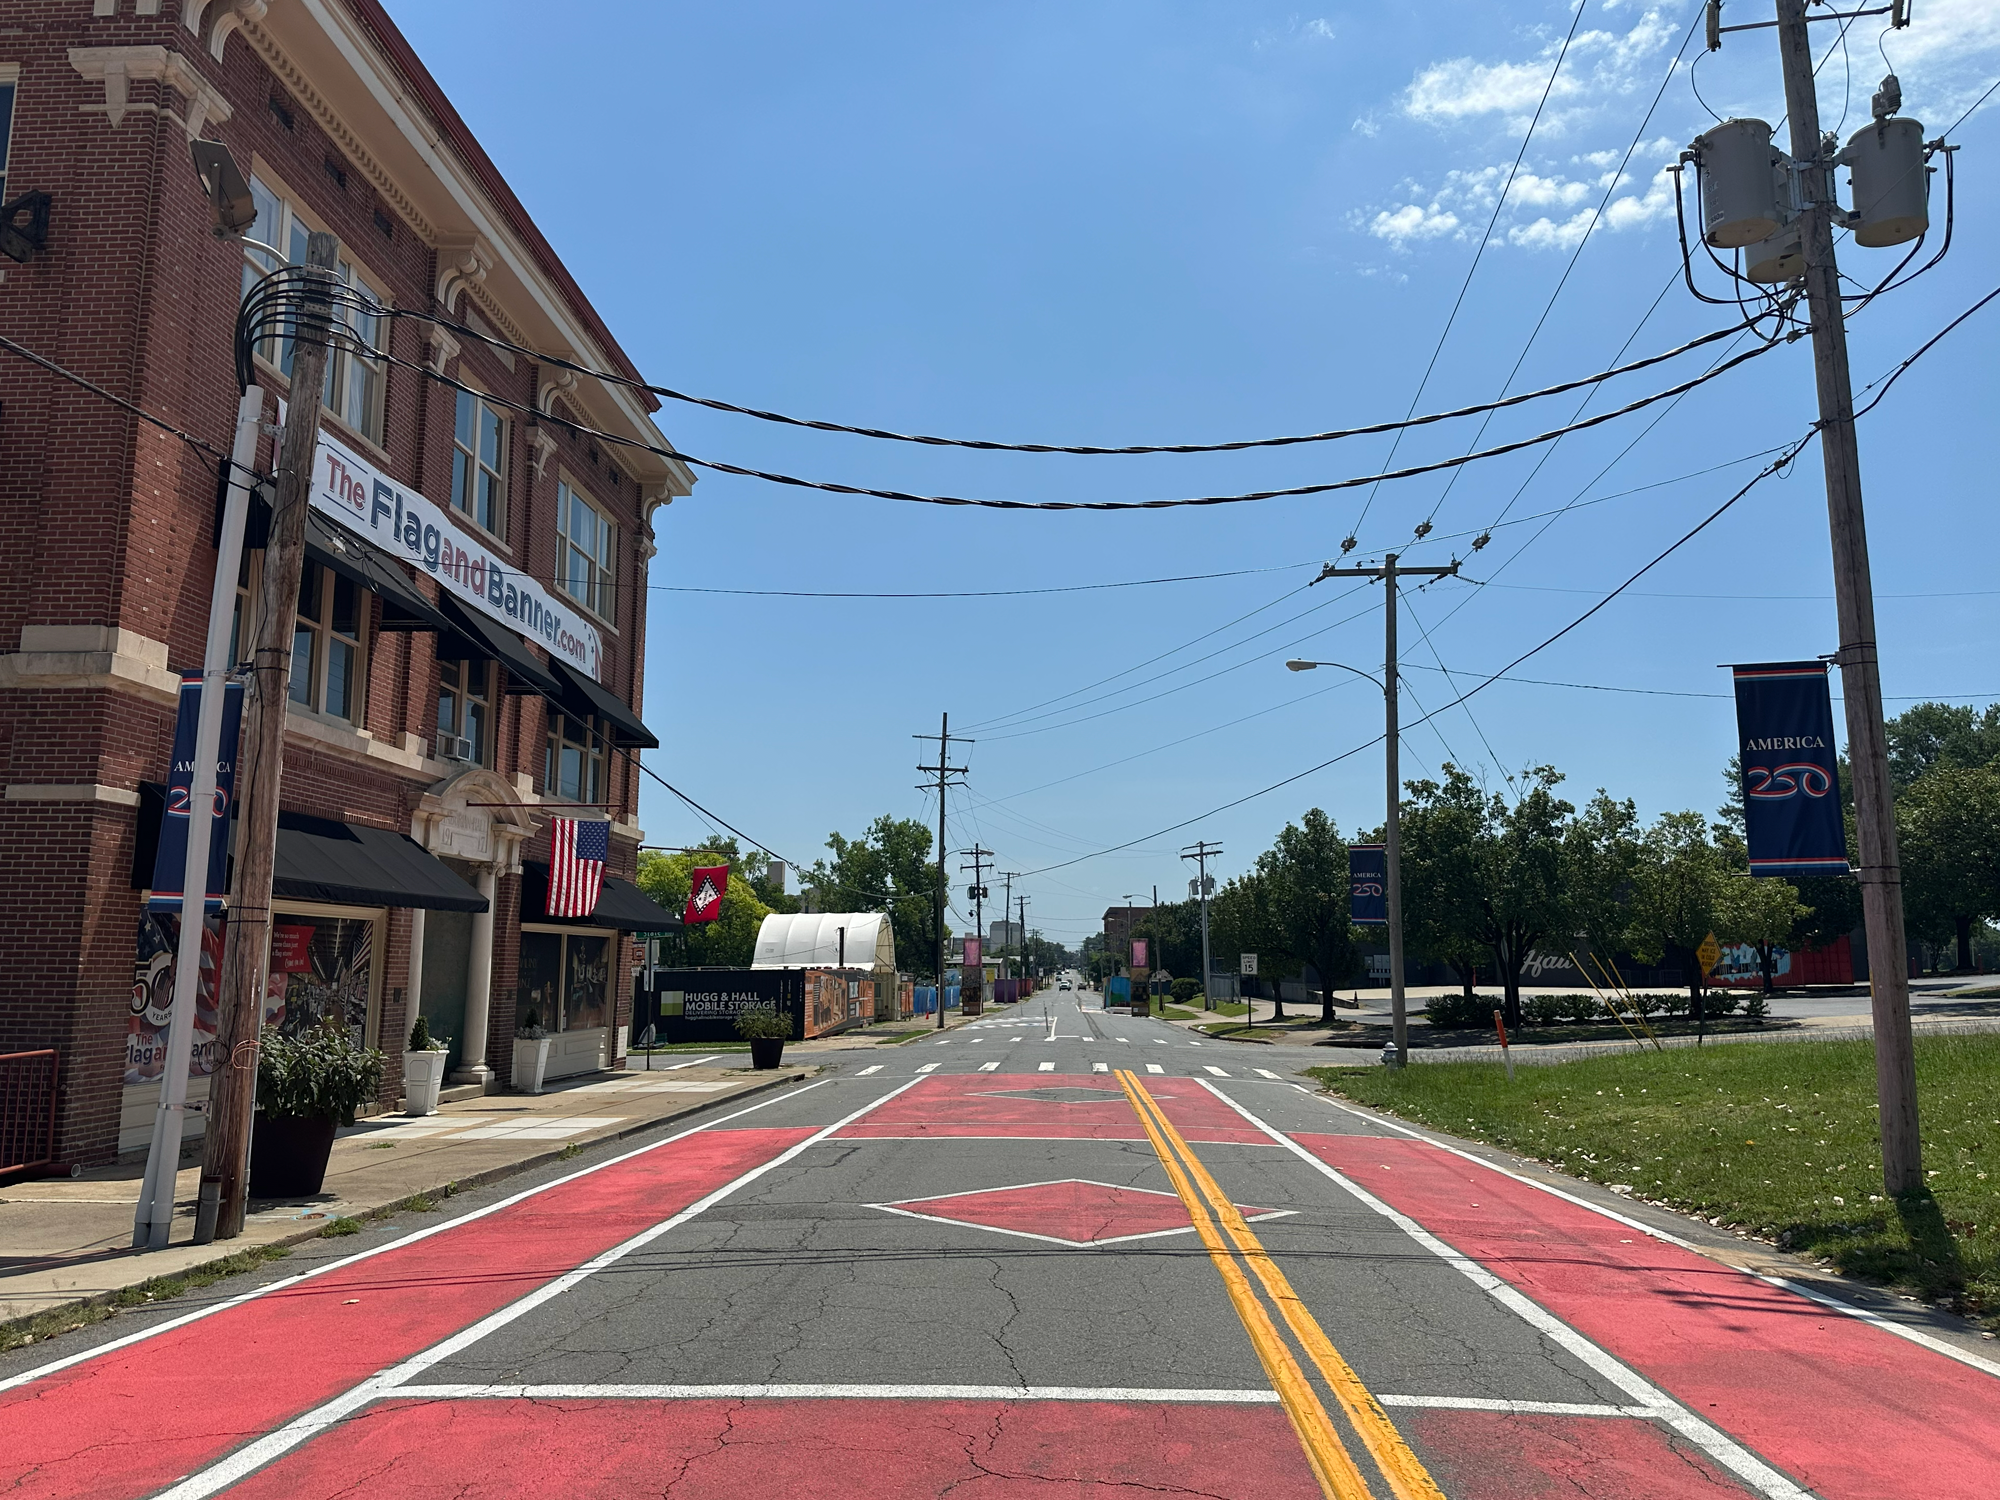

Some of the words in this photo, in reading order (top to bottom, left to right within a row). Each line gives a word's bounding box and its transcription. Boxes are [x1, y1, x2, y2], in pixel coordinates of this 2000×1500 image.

[326, 453, 366, 511] The
[369, 477, 586, 664] FlagandBanner.com
[1746, 735, 1825, 751] AMERICA
[1747, 762, 1832, 800] 250
[1353, 883, 1382, 897] 250
[1244, 963, 1254, 973] 15
[685, 992, 718, 1002] HUGG
[720, 992, 729, 1001] &
[731, 991, 760, 1001] HALL
[685, 1001, 725, 1011] MOBILE
[727, 1000, 777, 1010] STORAGE
[151, 1011, 173, 1022] YEARS
[135, 1033, 153, 1045] The
